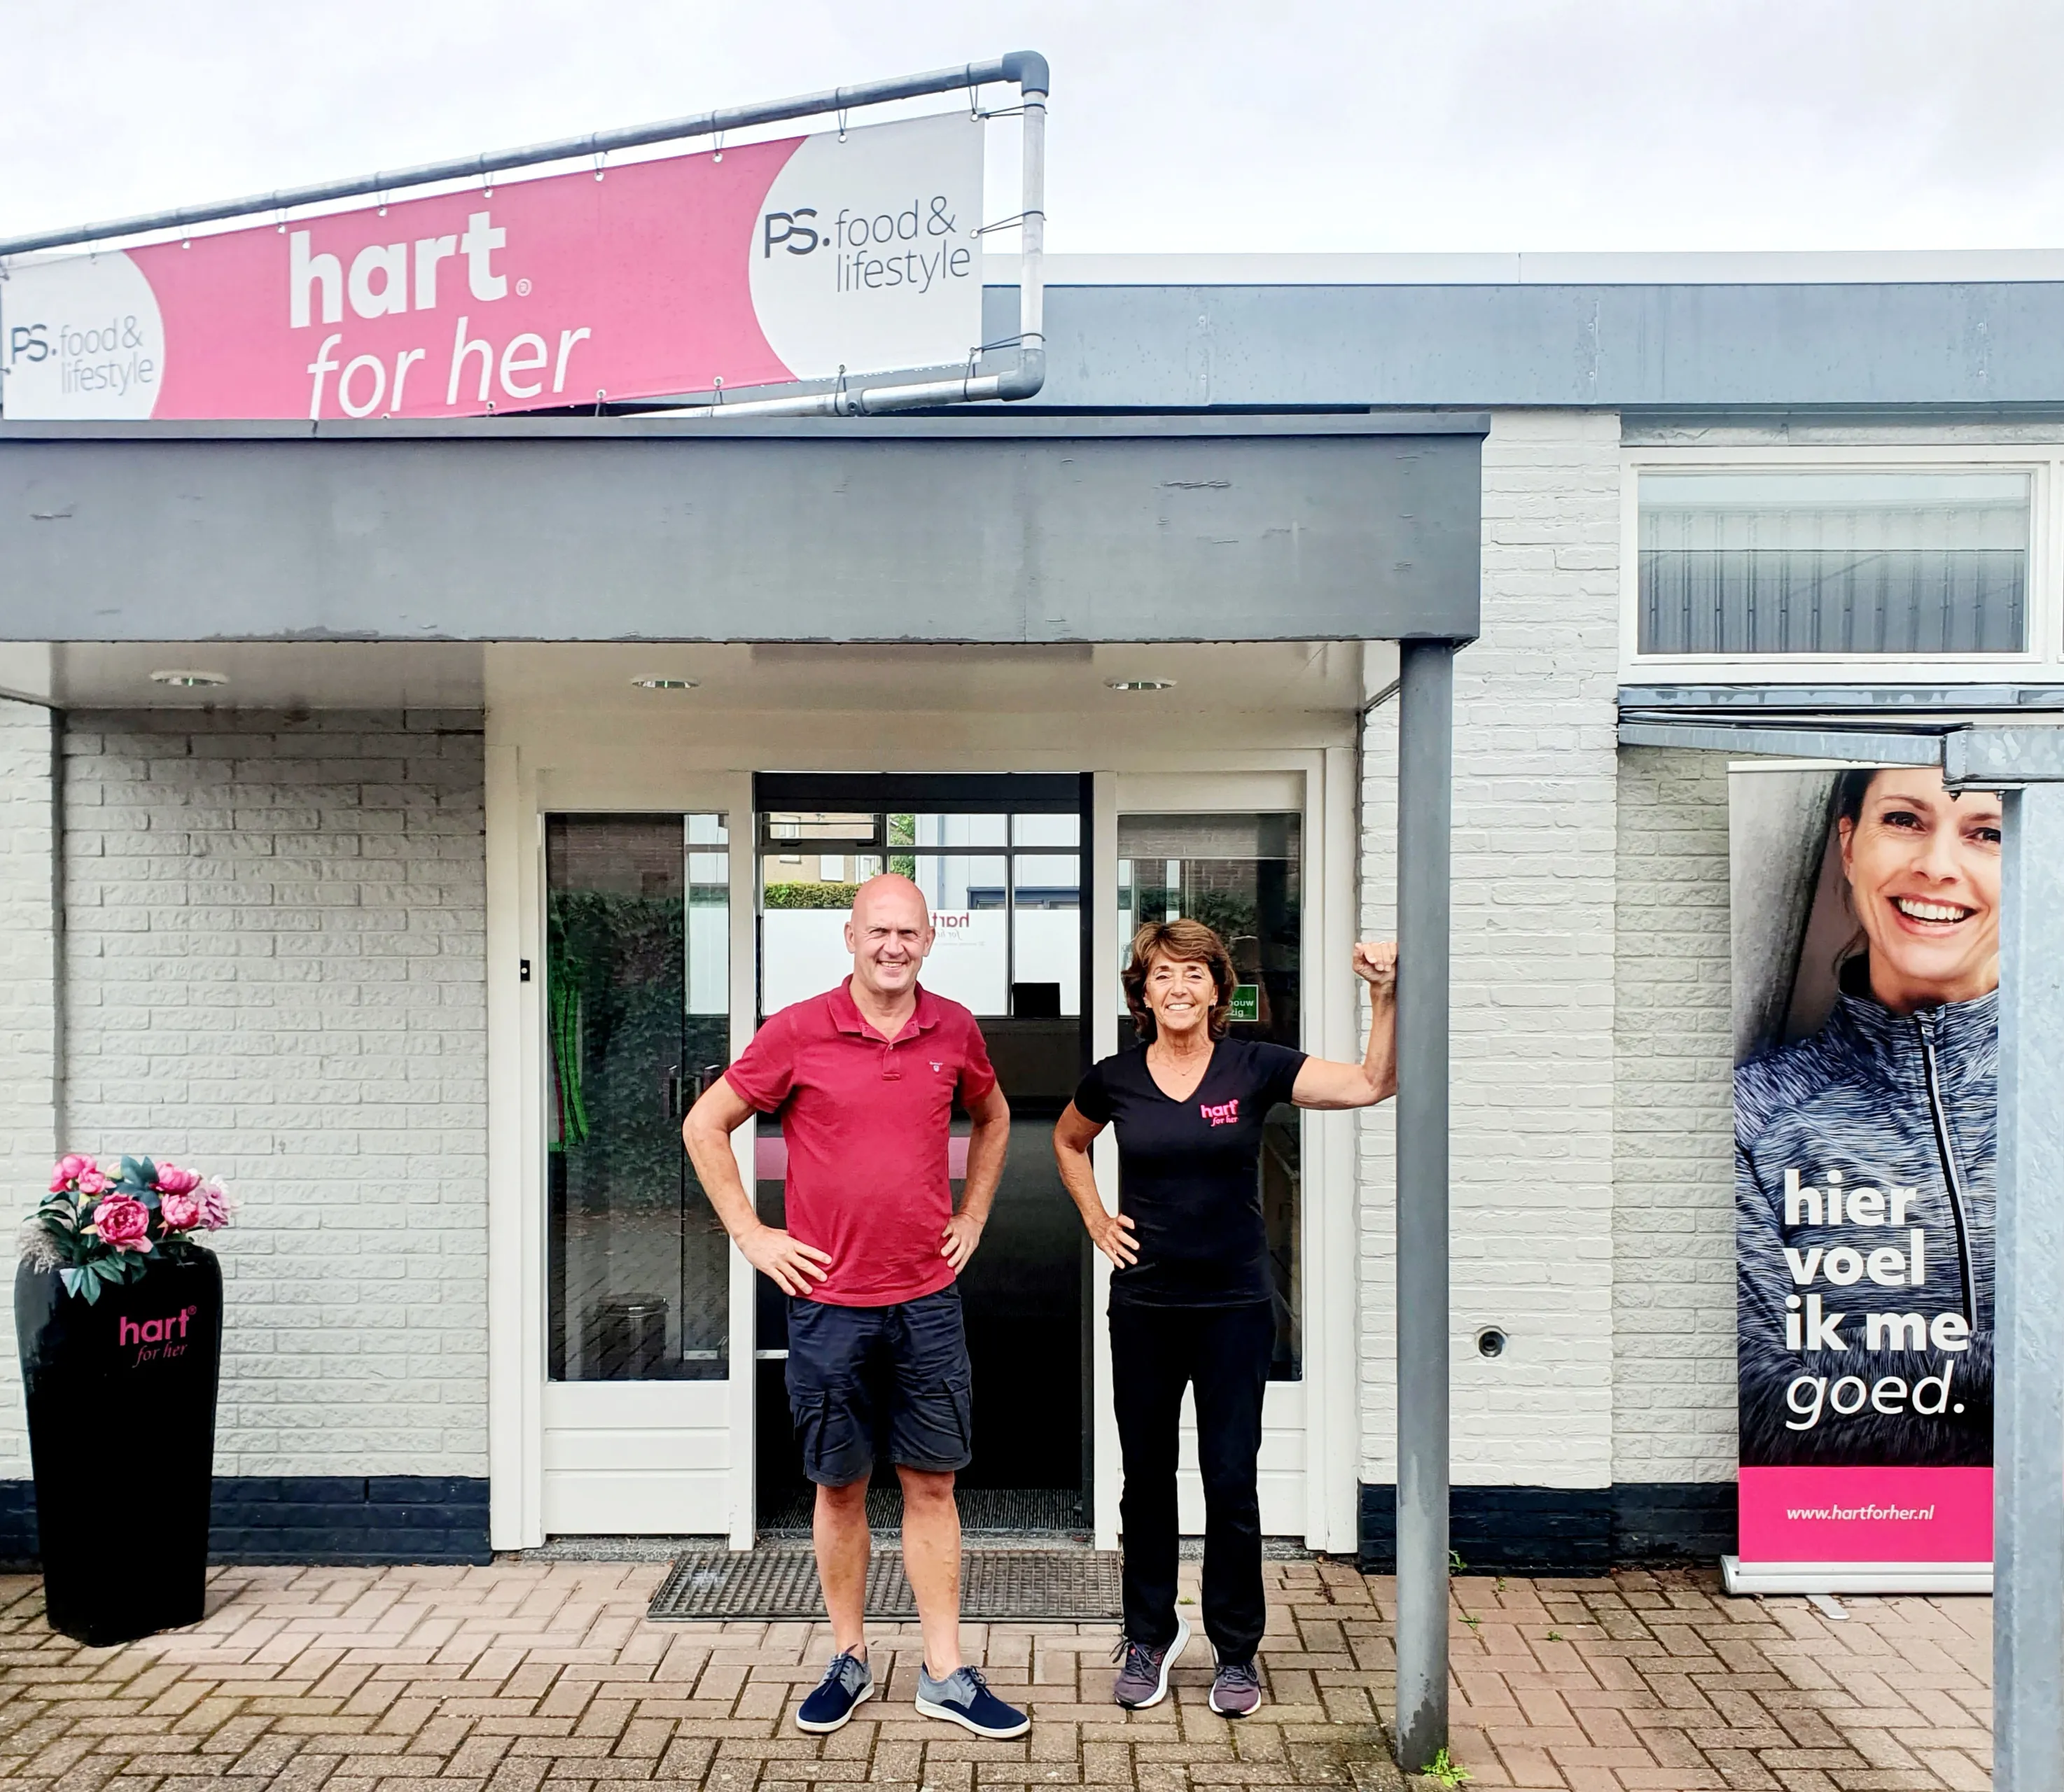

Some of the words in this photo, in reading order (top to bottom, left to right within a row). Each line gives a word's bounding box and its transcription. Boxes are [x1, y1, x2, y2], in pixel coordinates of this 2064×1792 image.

[837, 239, 971, 294] lifestyle
[61, 351, 154, 397] lifestyle
[306, 333, 426, 420] for
[446, 316, 592, 406] her
[1211, 1116, 1225, 1127] for
[1784, 1168, 1918, 1226] hier
[1782, 1228, 1925, 1287] voel
[1785, 1294, 1850, 1351] ik
[1866, 1312, 1969, 1352] me
[132, 1345, 161, 1368] for
[162, 1340, 188, 1358] her
[1785, 1359, 1965, 1432] goed.
[1786, 1504, 1935, 1521] www.hartforher.nl
